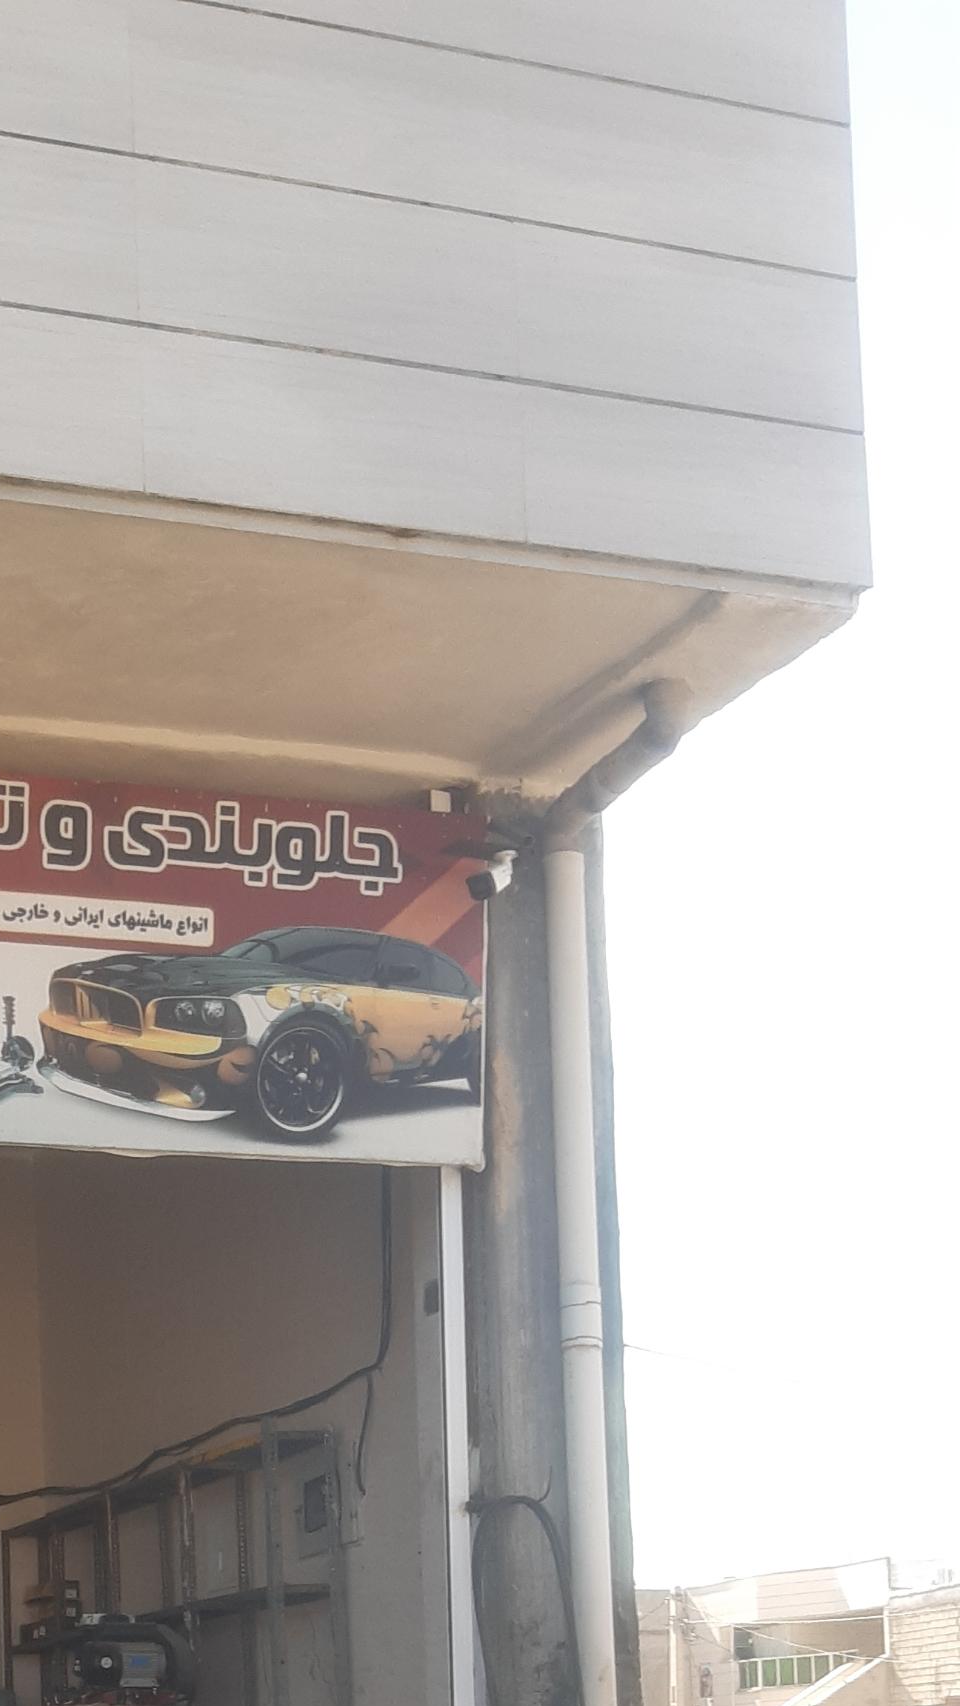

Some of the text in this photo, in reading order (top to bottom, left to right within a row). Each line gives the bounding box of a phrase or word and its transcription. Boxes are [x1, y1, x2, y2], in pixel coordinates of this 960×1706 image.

[41, 798, 93, 871] و
[104, 800, 402, 896] جلوبندی
[2, 904, 209, 935] انواع ماشینهای ایرانی و خارجی
